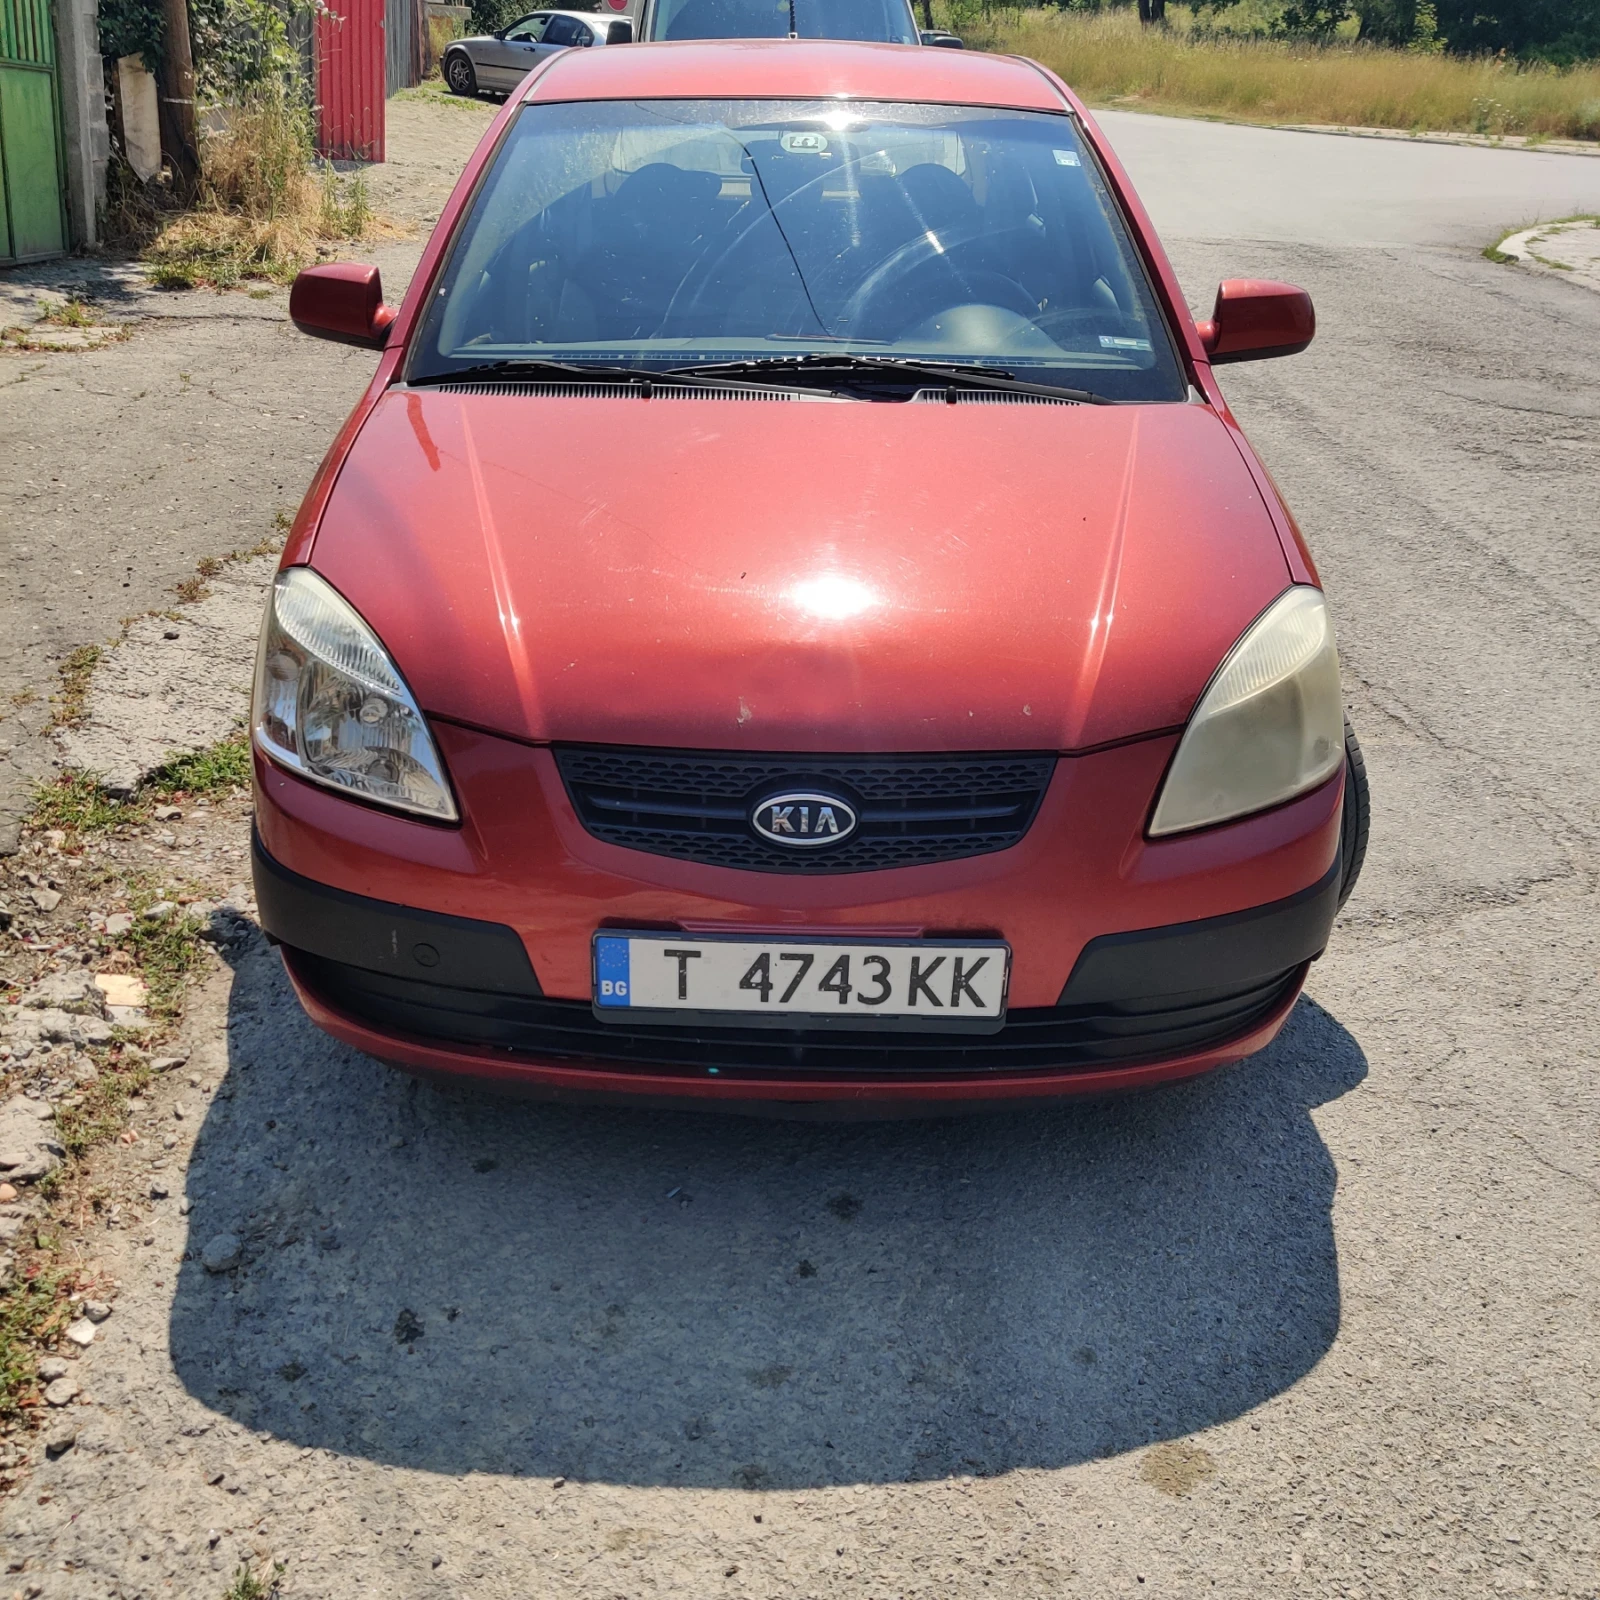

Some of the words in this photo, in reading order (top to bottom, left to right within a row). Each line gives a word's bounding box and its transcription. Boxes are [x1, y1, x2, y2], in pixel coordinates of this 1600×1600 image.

[771, 806, 838, 833] KIA
[601, 980, 627, 996] BG
[664, 949, 701, 999] T
[739, 953, 892, 1005] 4743
[907, 956, 990, 1007] KK
